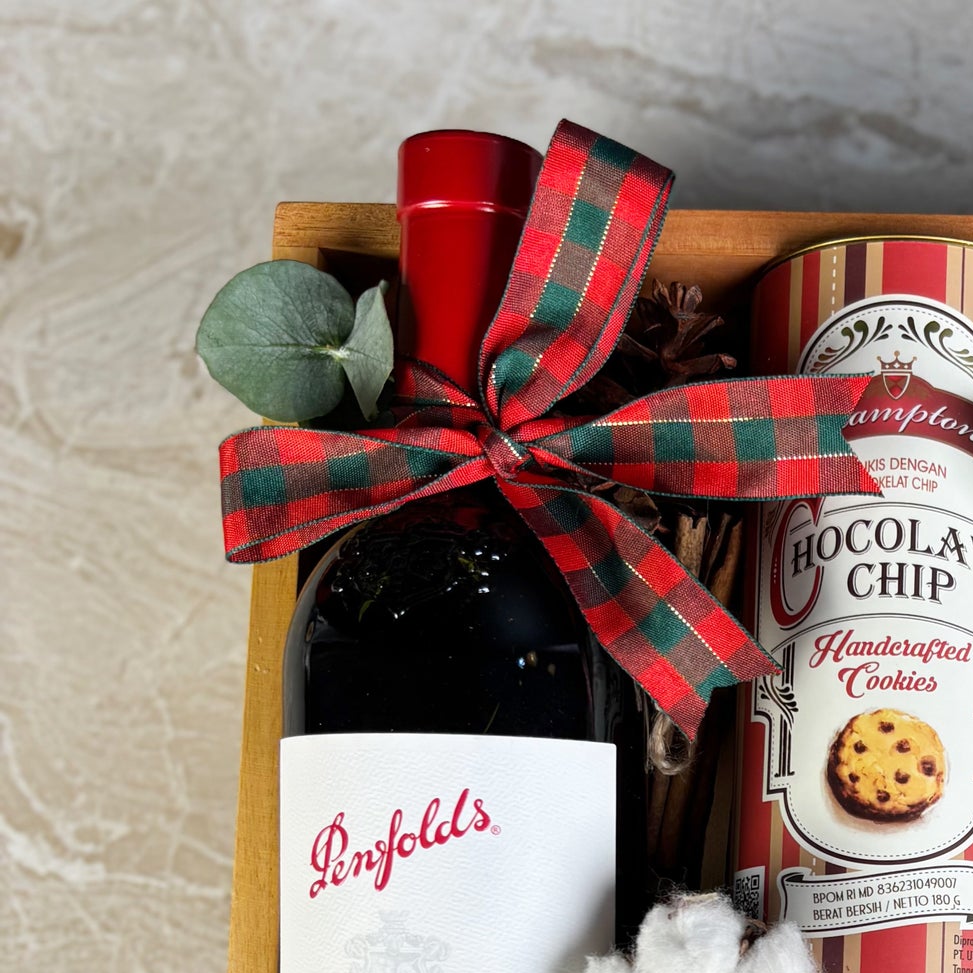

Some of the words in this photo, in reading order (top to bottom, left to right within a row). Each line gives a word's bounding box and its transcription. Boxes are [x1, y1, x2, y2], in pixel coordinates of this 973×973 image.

[872, 475, 909, 488] OKELAT
[912, 477, 938, 492] CHIP
[890, 457, 947, 479] DENGAN
[847, 562, 957, 605] CHIP
[808, 629, 972, 669] Handcrafted
[838, 661, 937, 699] Cookies
[309, 788, 492, 899] Penfolds
[813, 891, 844, 904] BPOM
[858, 887, 874, 898] MD
[877, 877, 957, 895] 836231049007
[813, 907, 843, 921] BERAT
[846, 902, 882, 918] BERSIH
[893, 895, 929, 910] NETTO
[932, 894, 951, 906] 180
